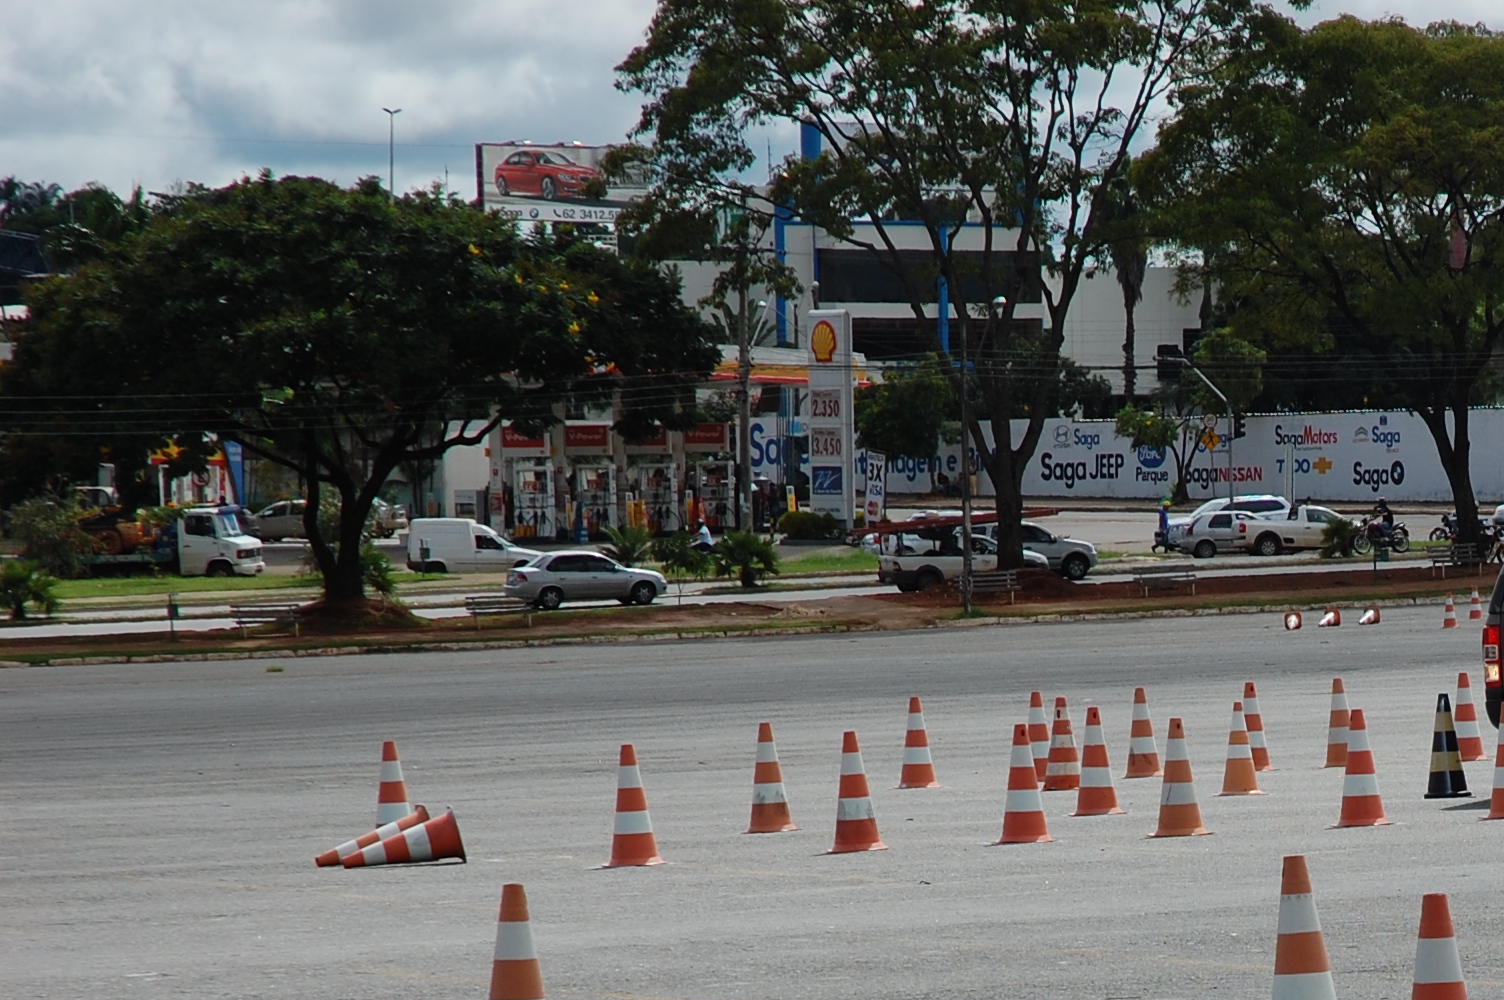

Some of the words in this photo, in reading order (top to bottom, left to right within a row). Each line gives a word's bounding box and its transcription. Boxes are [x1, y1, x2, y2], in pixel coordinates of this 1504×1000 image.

[563, 209, 576, 219] 62
[813, 399, 839, 418] 2.350
[814, 437, 841, 456] 3.450
[1074, 428, 1100, 450] Saga
[1371, 425, 1401, 448] Saga
[1041, 452, 1086, 489] Saga
[1089, 453, 1124, 480] JEEP
[1136, 466, 1169, 485] Parque
[1353, 461, 1389, 492] Saga
